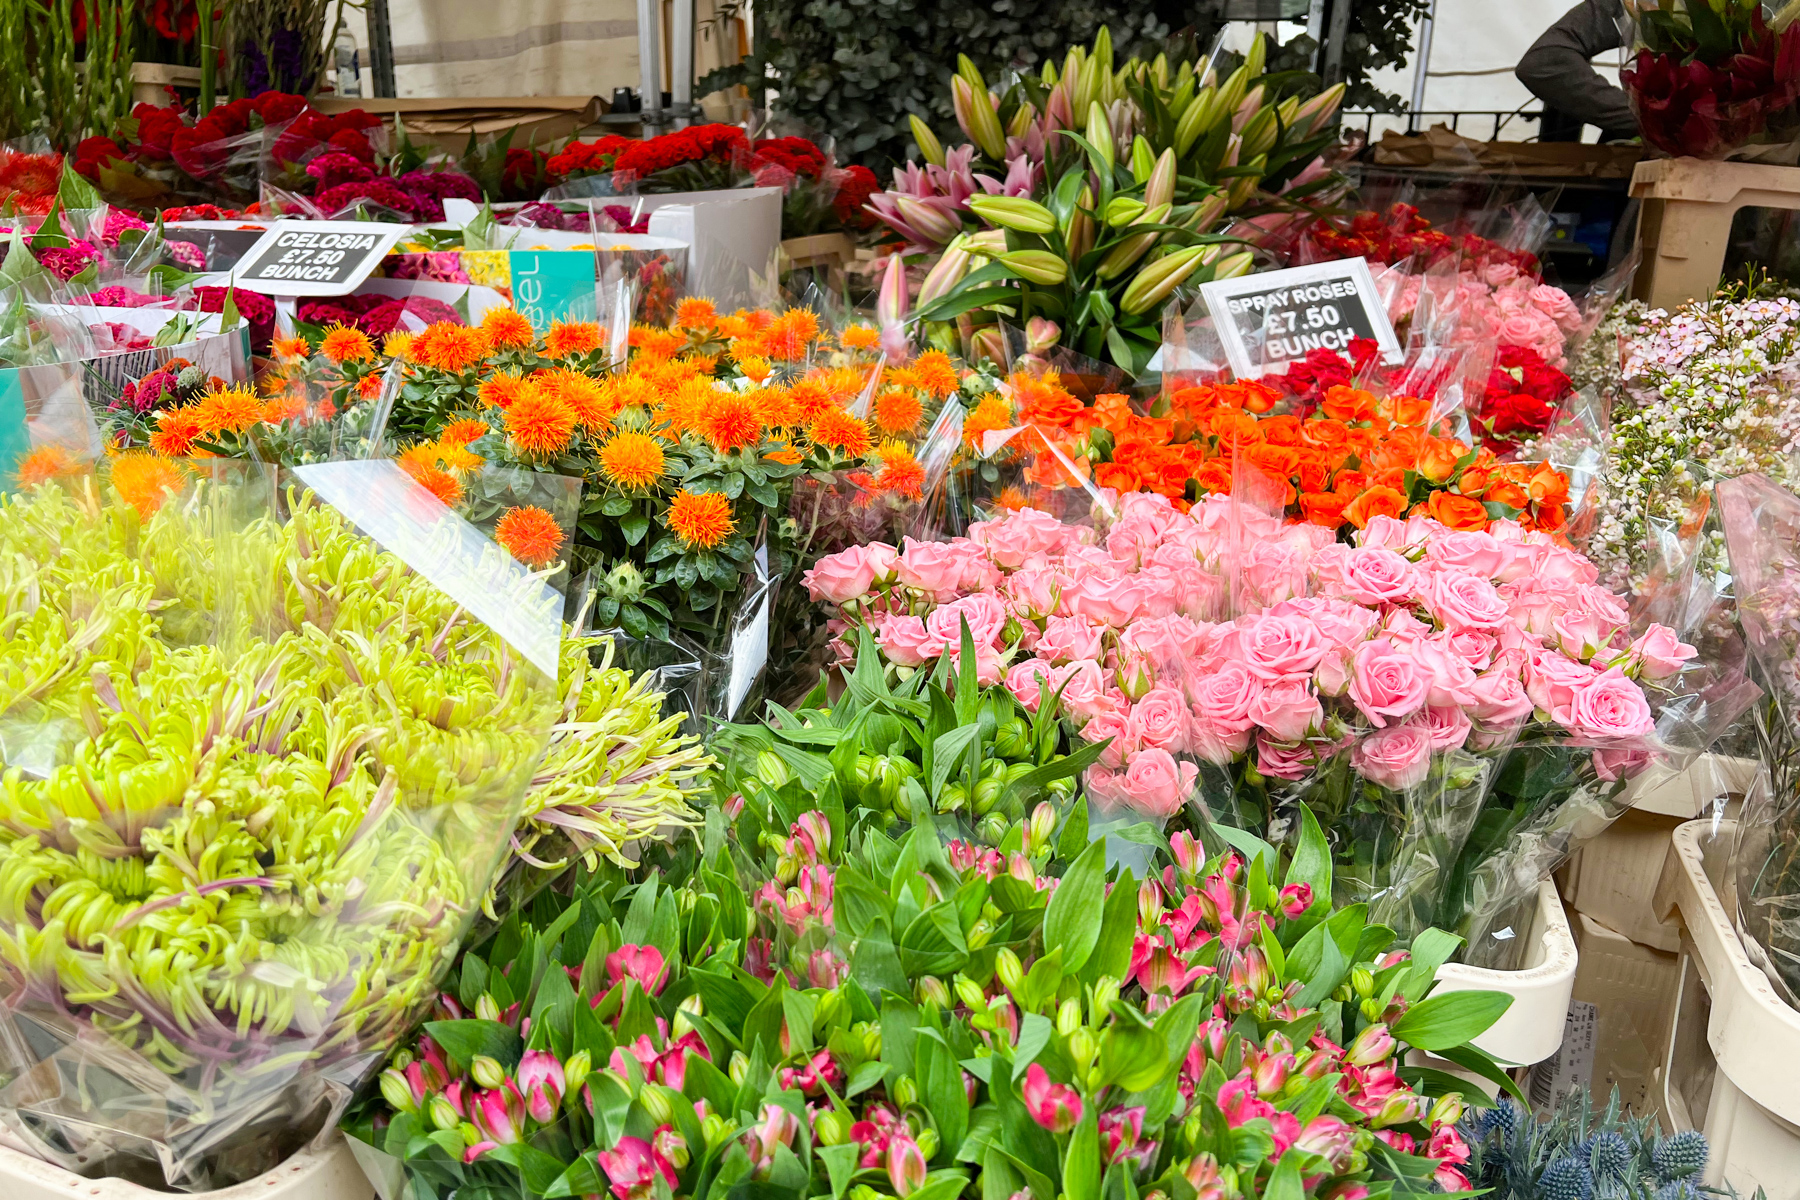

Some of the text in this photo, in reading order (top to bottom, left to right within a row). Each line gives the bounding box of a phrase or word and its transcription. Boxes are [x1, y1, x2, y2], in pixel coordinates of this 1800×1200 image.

[277, 232, 376, 250] CELOSIA
[278, 249, 346, 265] £7.50
[258, 264, 340, 281] BUNCH
[1228, 280, 1358, 315] SPRAY ROSES
[1266, 304, 1340, 335] £7.50
[1266, 327, 1356, 359] BUNCH
